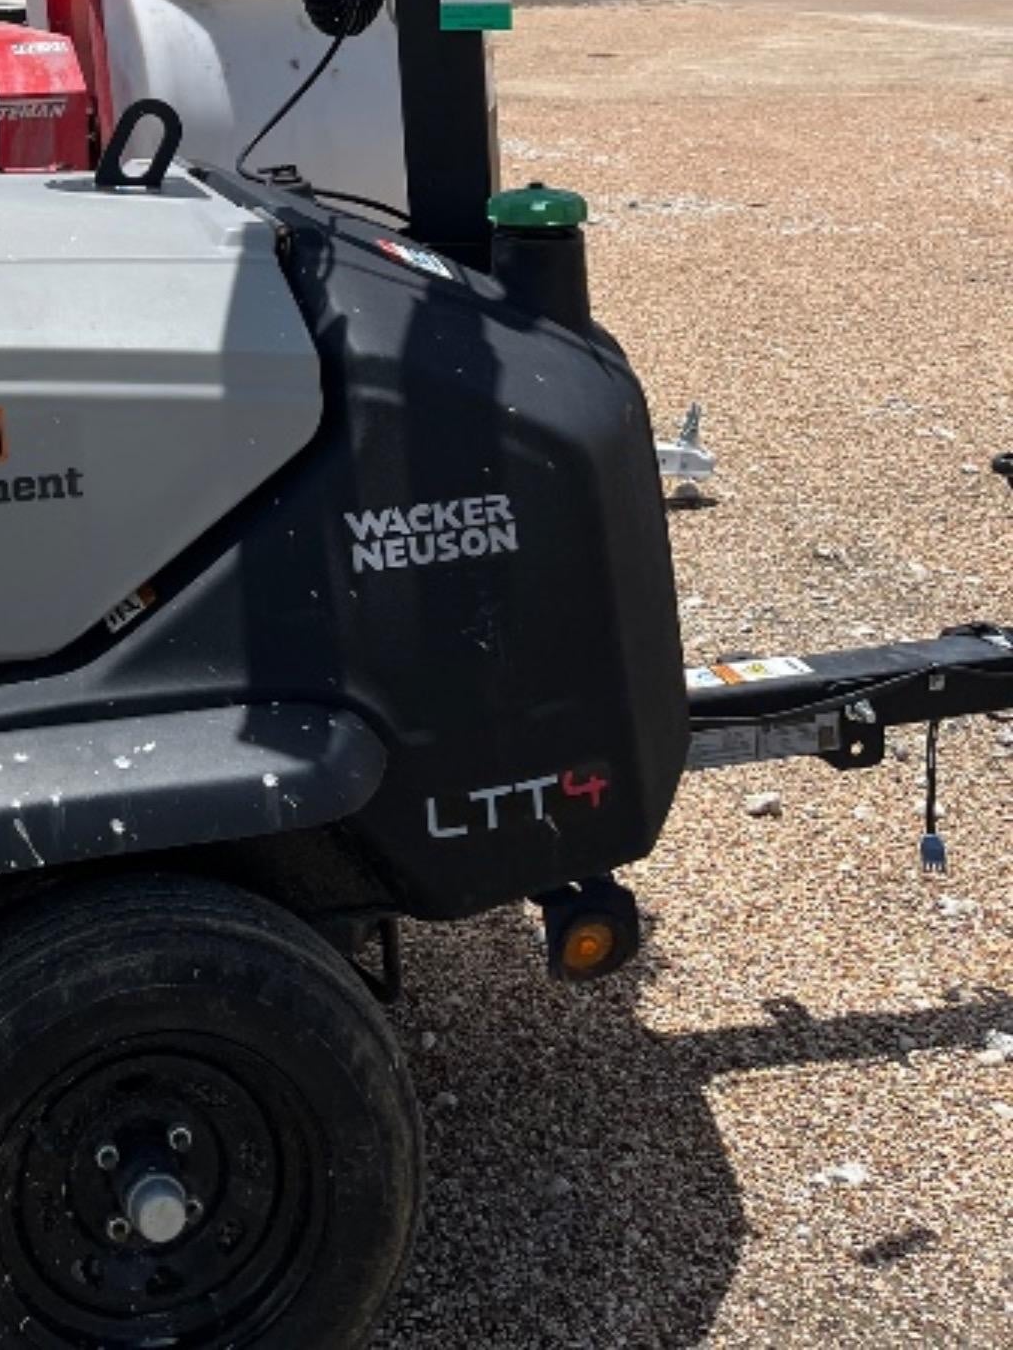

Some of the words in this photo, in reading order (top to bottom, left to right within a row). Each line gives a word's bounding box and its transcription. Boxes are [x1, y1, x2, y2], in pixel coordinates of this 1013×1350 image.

[344, 495, 516, 541] WACKER
[352, 522, 520, 573] NEUSON
[426, 770, 608, 839] LTT4
